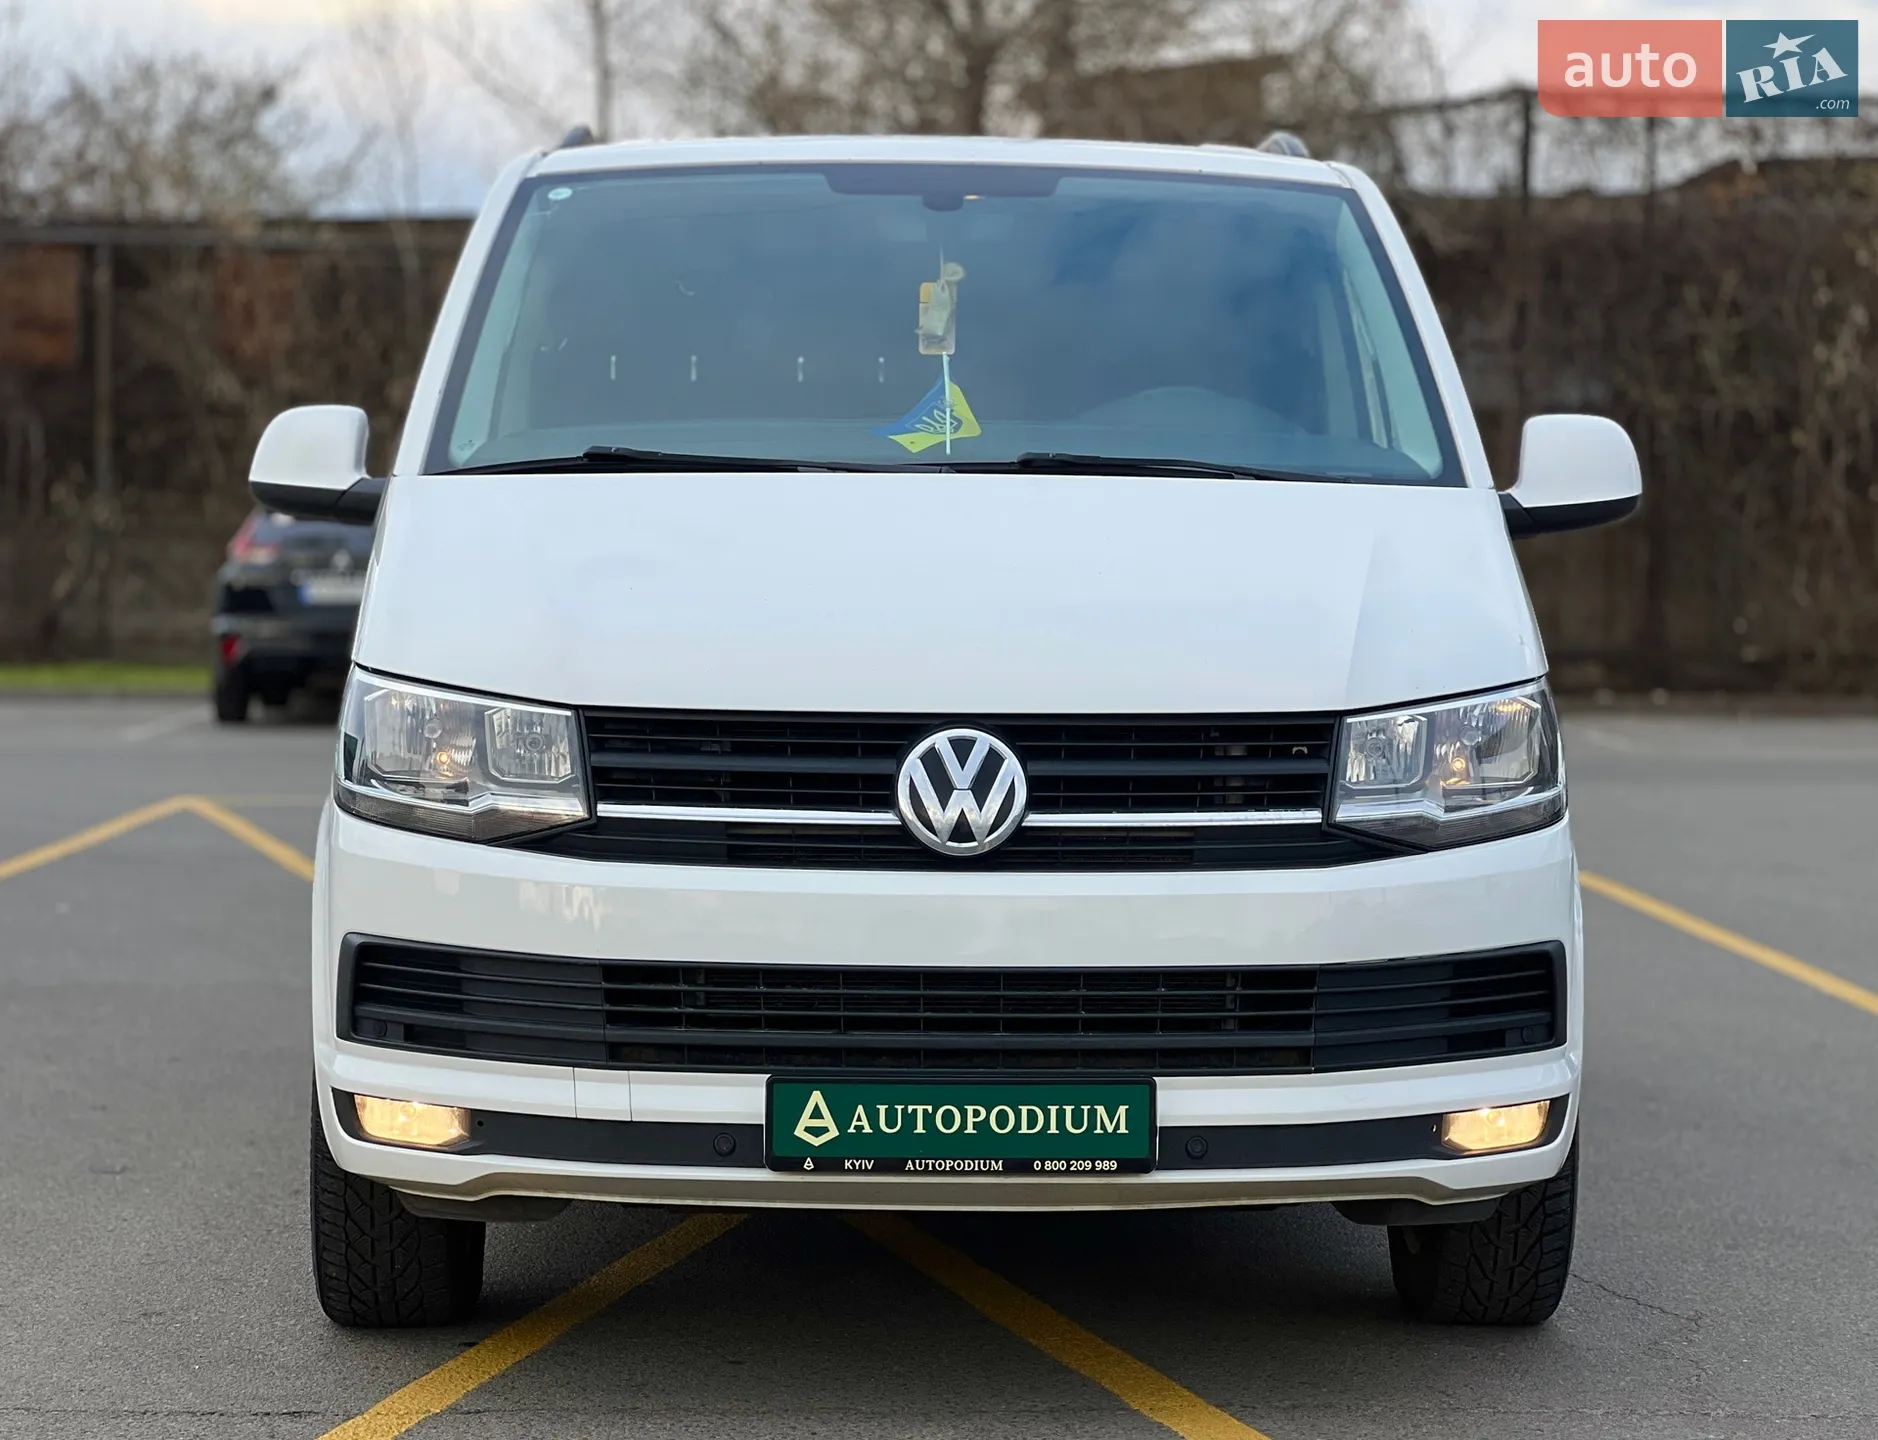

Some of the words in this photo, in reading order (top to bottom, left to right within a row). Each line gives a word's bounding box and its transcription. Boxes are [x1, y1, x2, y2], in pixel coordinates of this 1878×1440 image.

[847, 1104, 1130, 1134] AUTOPODIUM
[844, 1159, 875, 1170] KYIV
[905, 1160, 1004, 1171] AUTOPODIUM
[1033, 1160, 1042, 1171] 0
[1044, 1160, 1067, 1171] 800
[1069, 1160, 1092, 1171] 209
[1094, 1160, 1118, 1171] 989
